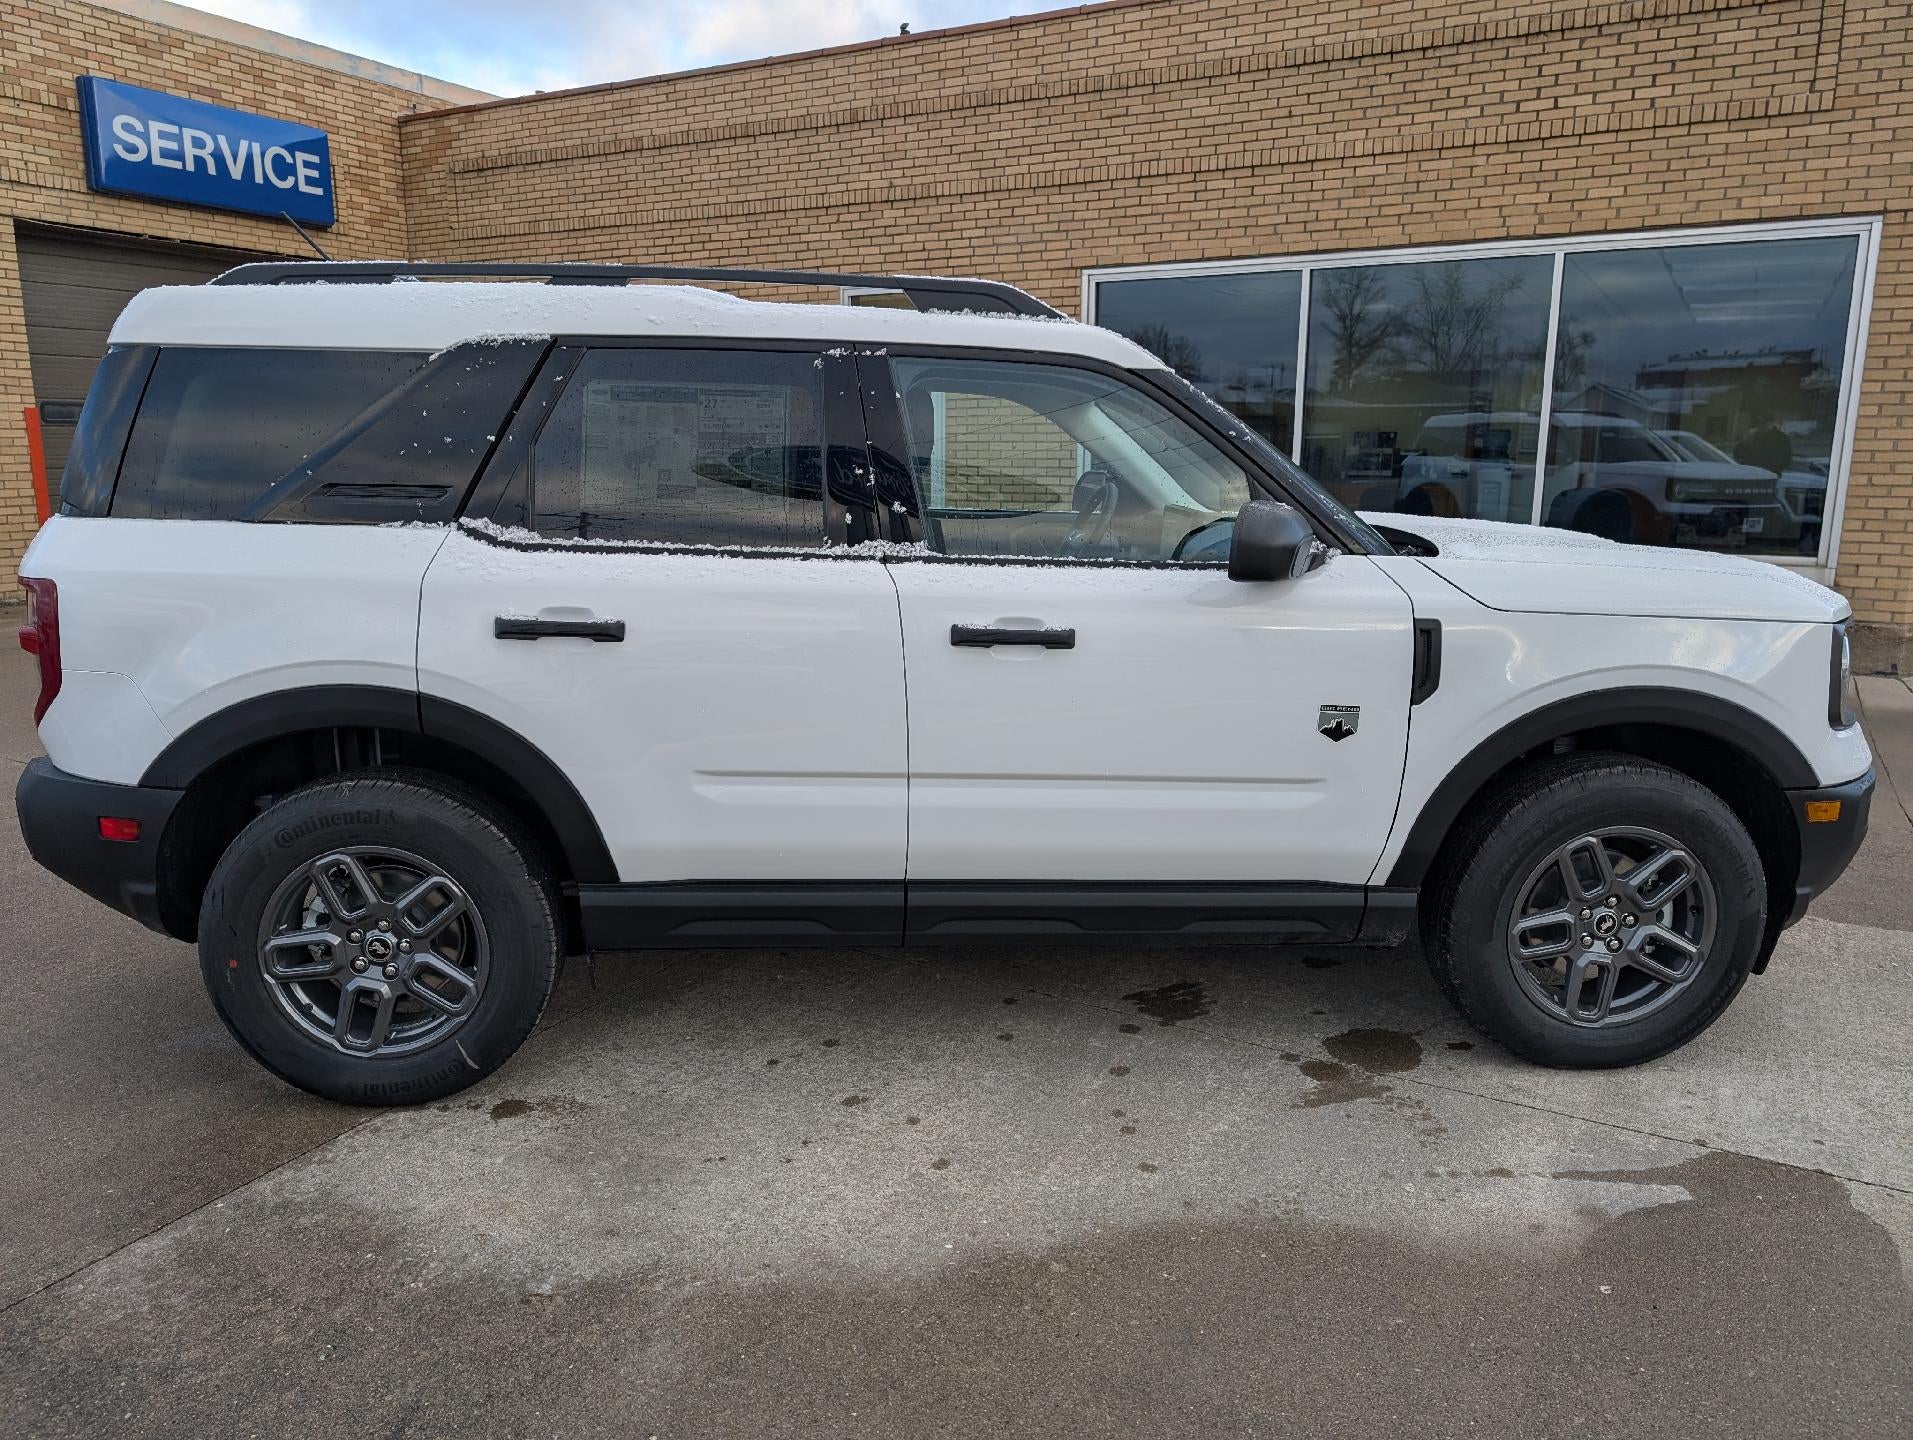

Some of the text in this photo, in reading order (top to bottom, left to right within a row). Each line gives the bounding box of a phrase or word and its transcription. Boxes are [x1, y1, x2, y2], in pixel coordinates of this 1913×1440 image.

[112, 114, 324, 196] SERVICE
[273, 808, 381, 849] Continental
[363, 1060, 466, 1097] Continental
